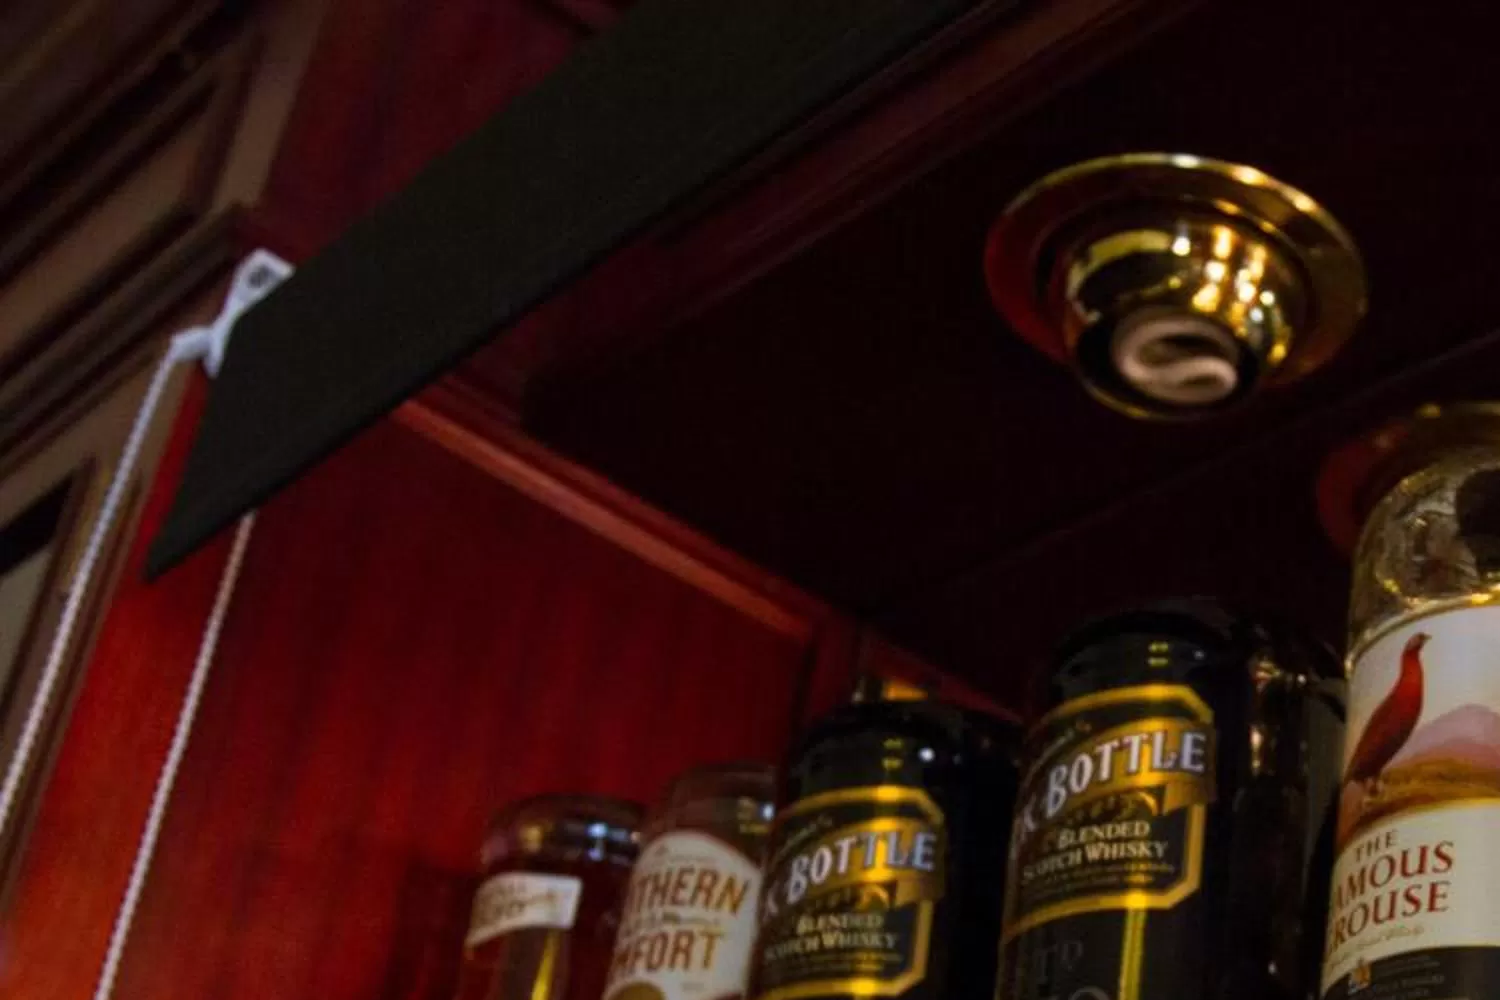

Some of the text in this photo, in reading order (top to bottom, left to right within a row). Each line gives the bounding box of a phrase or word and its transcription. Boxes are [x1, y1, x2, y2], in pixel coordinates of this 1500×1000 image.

[1045, 731, 1208, 820] BOTTLE
[786, 831, 937, 905] BOTTLE
[1057, 819, 1152, 851] BLENDED
[1084, 839, 1169, 864] WHISKY
[1354, 829, 1398, 862] THE
[1334, 839, 1455, 910] AMOUS
[1330, 879, 1452, 953] ROUSE
